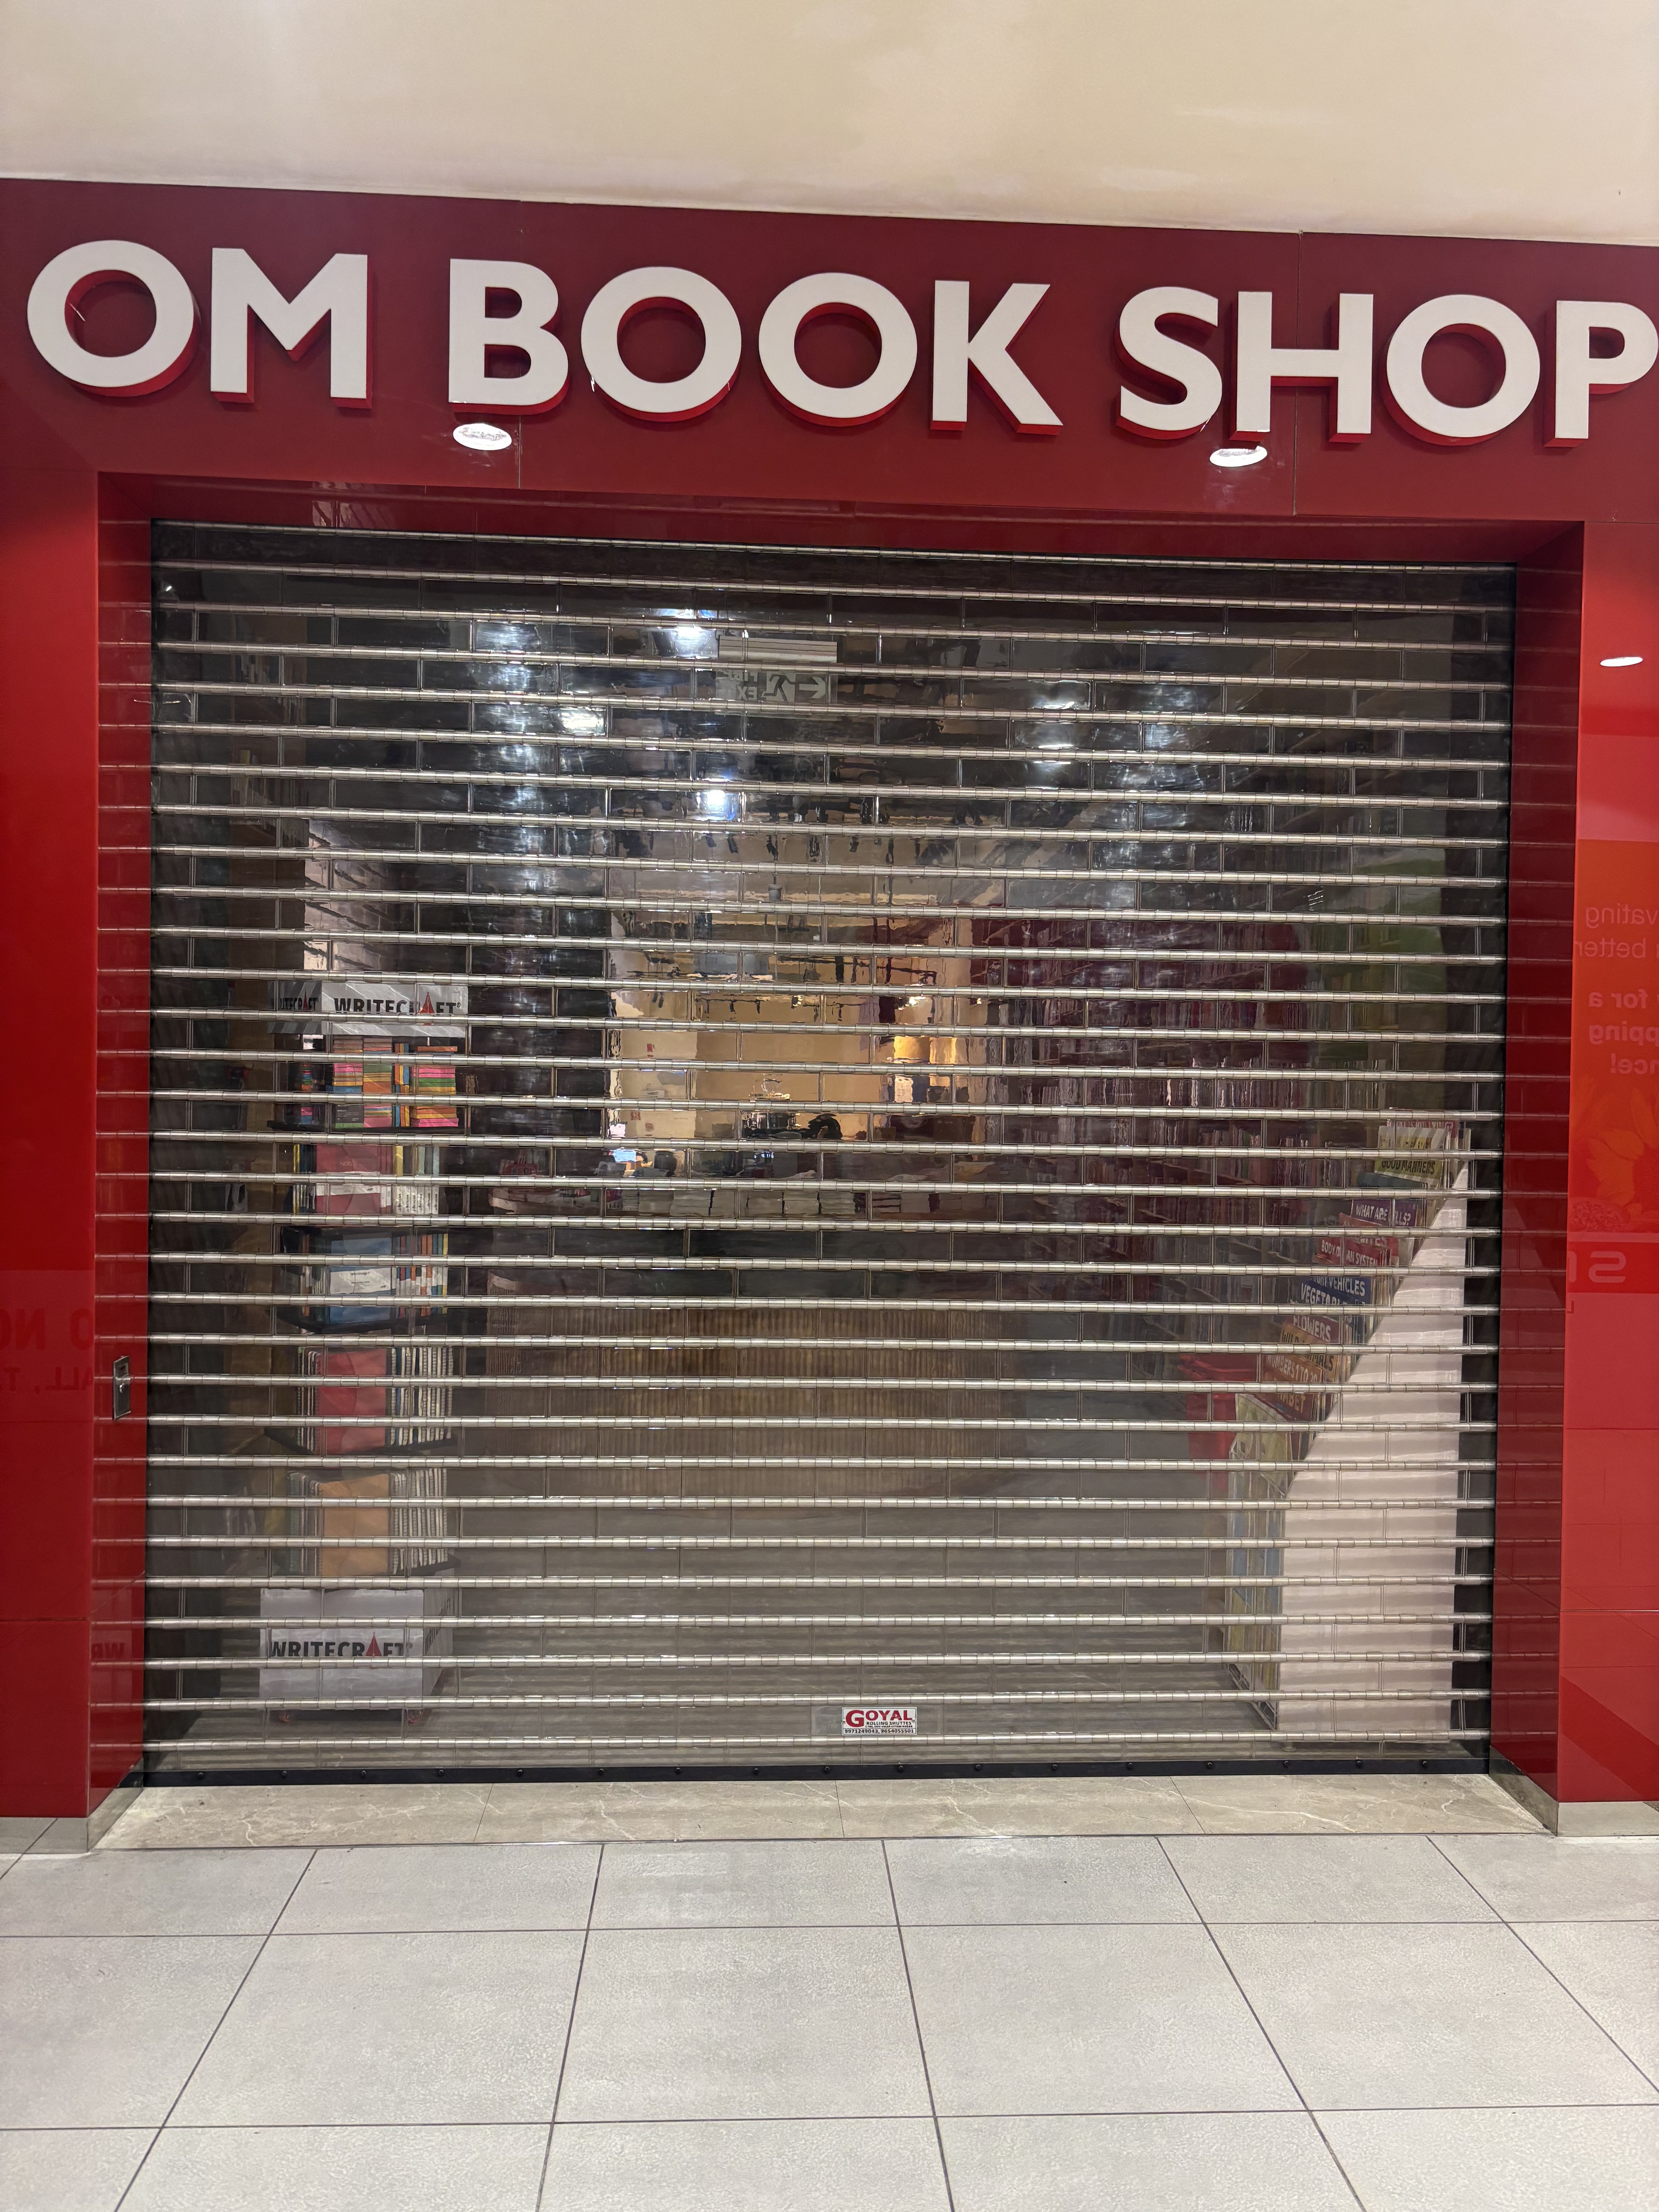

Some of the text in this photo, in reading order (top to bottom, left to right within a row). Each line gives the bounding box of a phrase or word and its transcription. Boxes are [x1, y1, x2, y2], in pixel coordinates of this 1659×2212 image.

[27, 239, 1659, 445] OM BOOK SHOP
[1356, 1205, 1374, 1218] WHAT
[1374, 1207, 1388, 1221] ARE
[1329, 1277, 1365, 1297] VEHICLES
[846, 1710, 912, 1727] GOYAL
